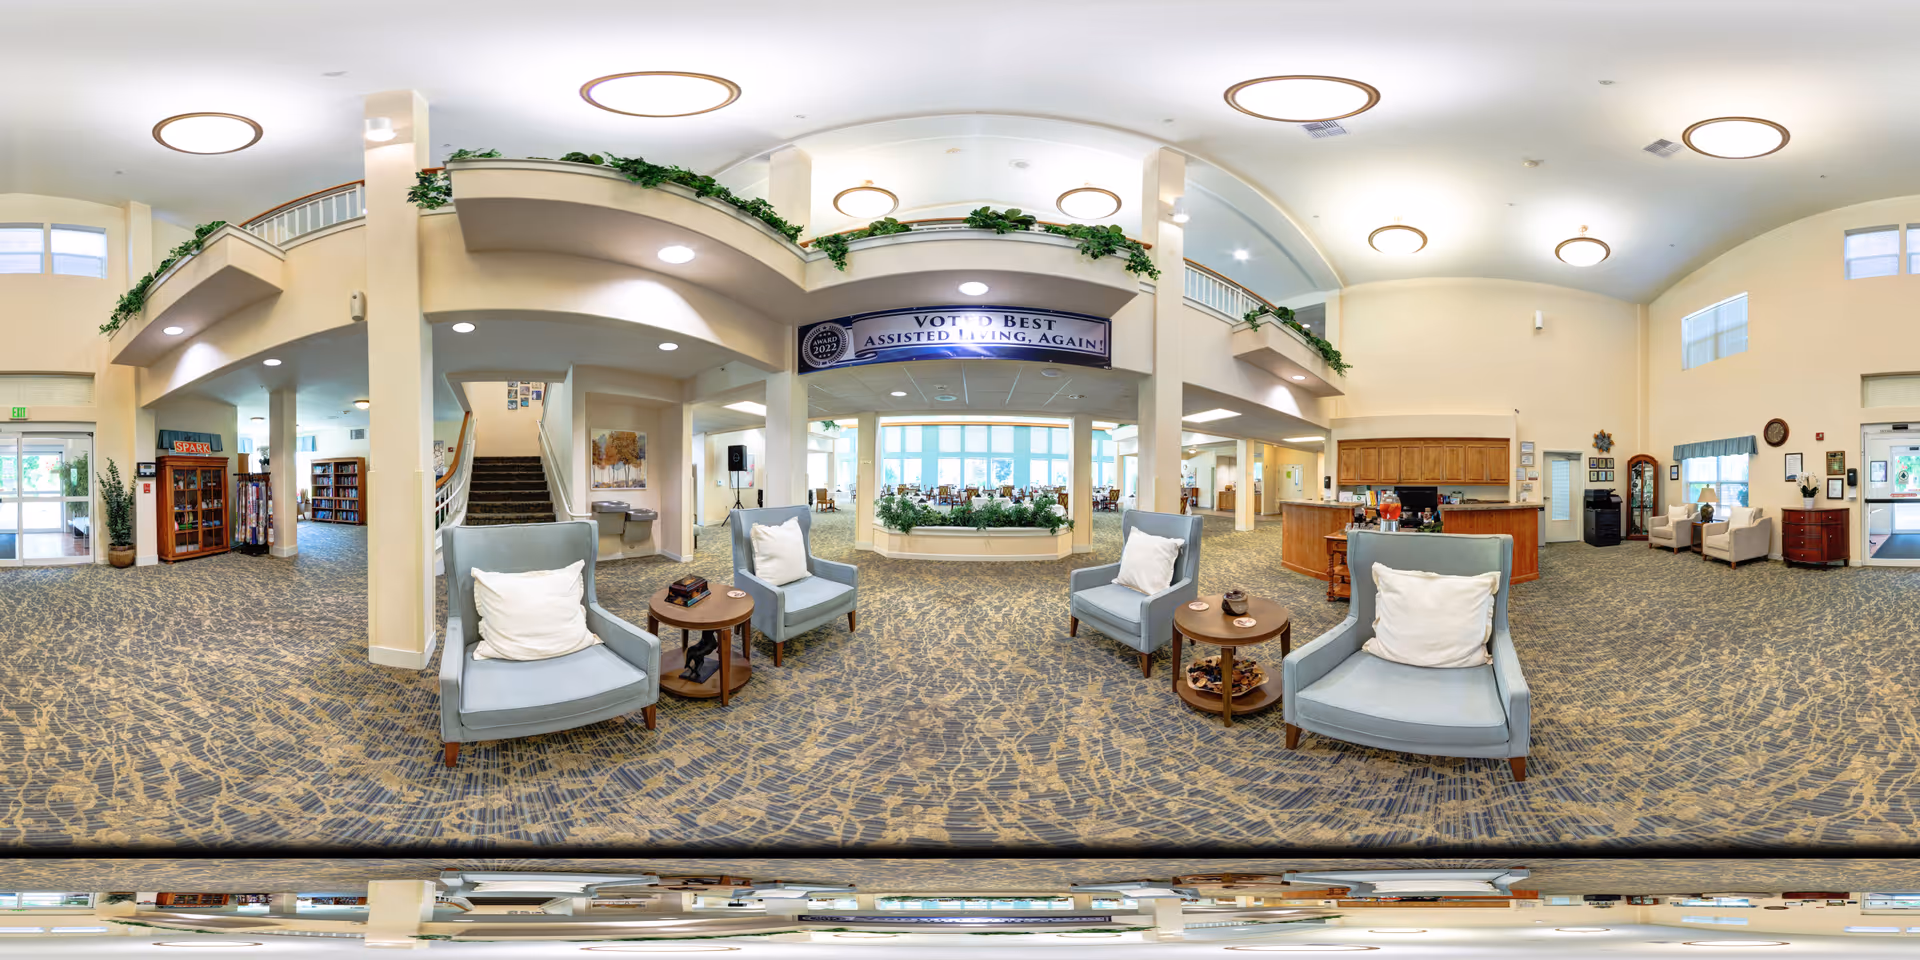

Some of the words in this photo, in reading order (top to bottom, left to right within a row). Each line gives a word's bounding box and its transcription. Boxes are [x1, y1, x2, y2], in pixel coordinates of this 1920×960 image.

[914, 315, 993, 328] VOTD
[1004, 315, 1057, 331] BEST
[812, 335, 838, 346] AWARD
[864, 330, 950, 347] ASSISTED
[1039, 332, 1104, 351] AGAIN!
[813, 343, 837, 355] 2022
[12, 406, 26, 418] EXIT
[176, 442, 210, 453] SPARK
